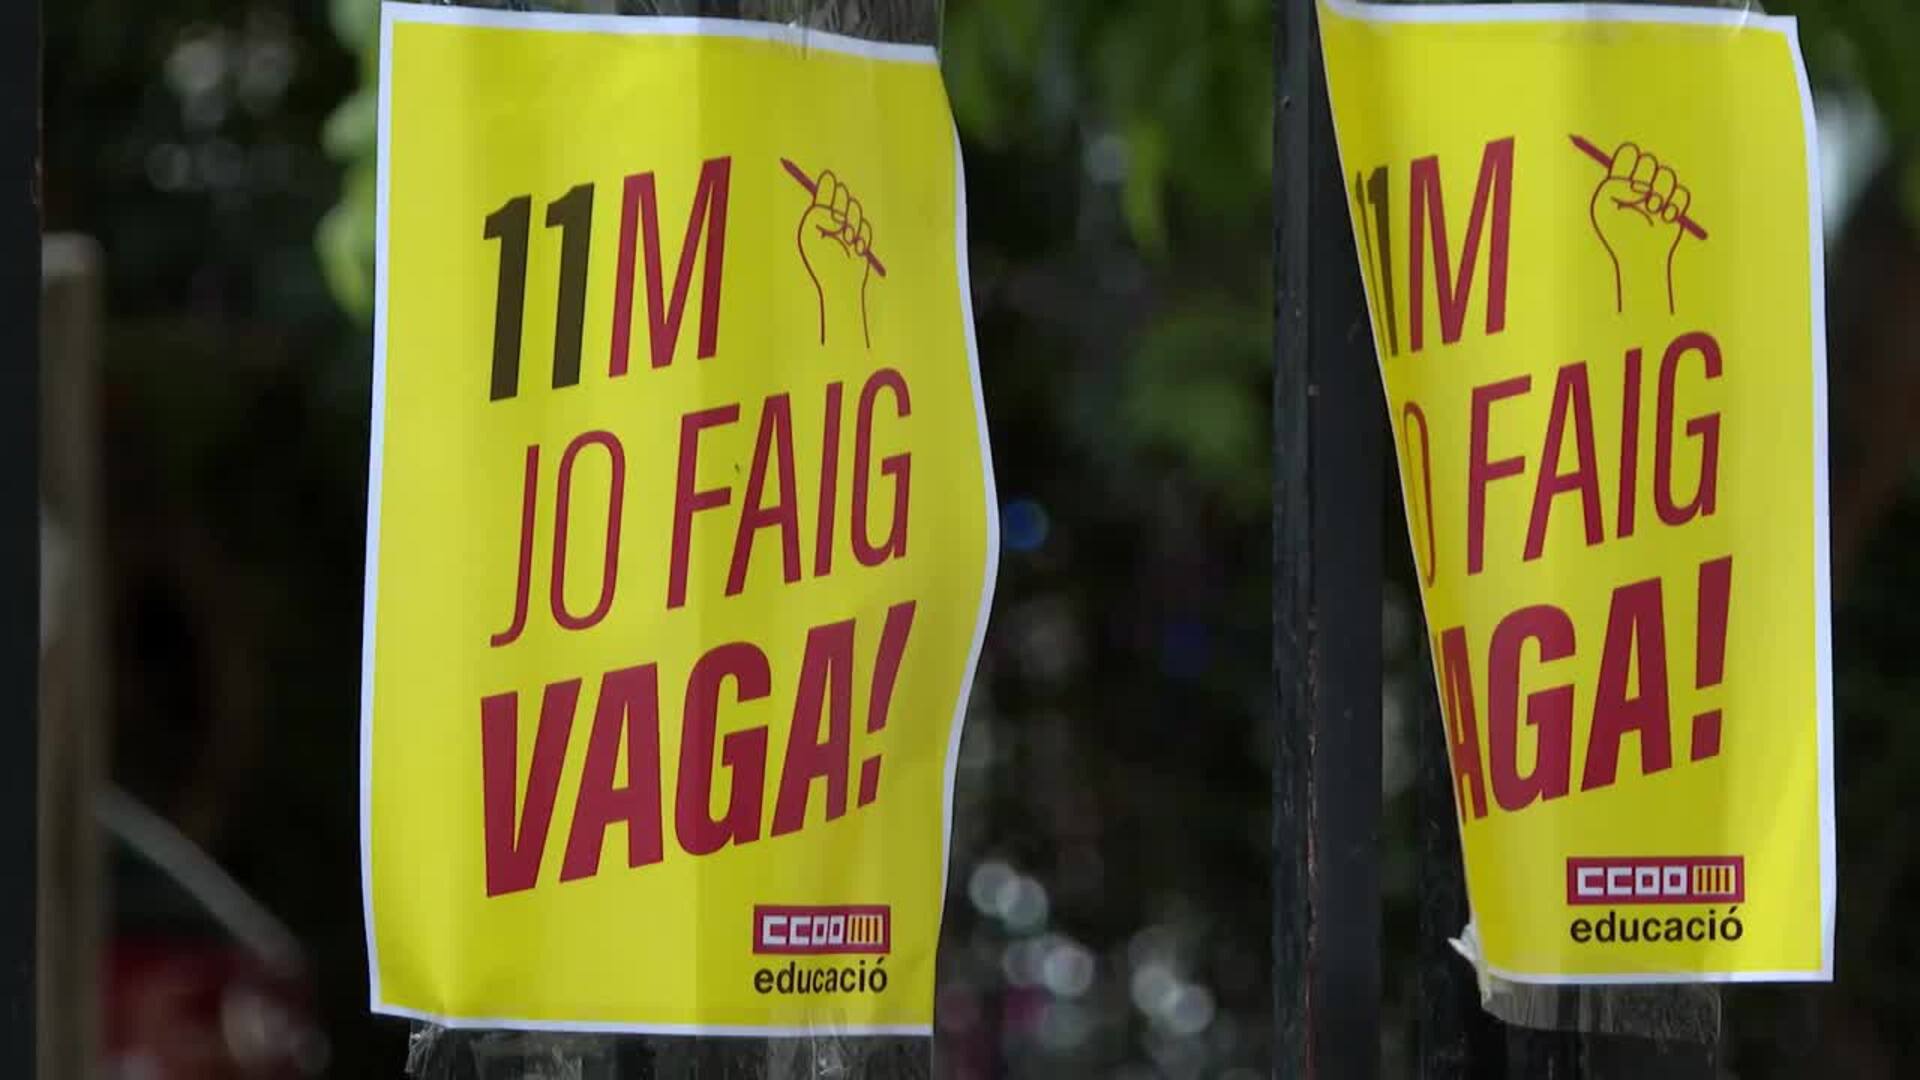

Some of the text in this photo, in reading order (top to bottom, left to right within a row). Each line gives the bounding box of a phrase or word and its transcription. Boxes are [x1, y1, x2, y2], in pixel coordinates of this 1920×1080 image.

[483, 156, 732, 402] 11M
[490, 369, 912, 648] JO FAIG
[1397, 331, 1724, 588] O FAIG
[480, 600, 917, 898] VAGA!
[1434, 556, 1734, 825] AGA!
[753, 956, 889, 995] educació
[763, 915, 846, 946] CCOO
[1569, 905, 1744, 944] educació
[1577, 865, 1689, 897] CCOO
